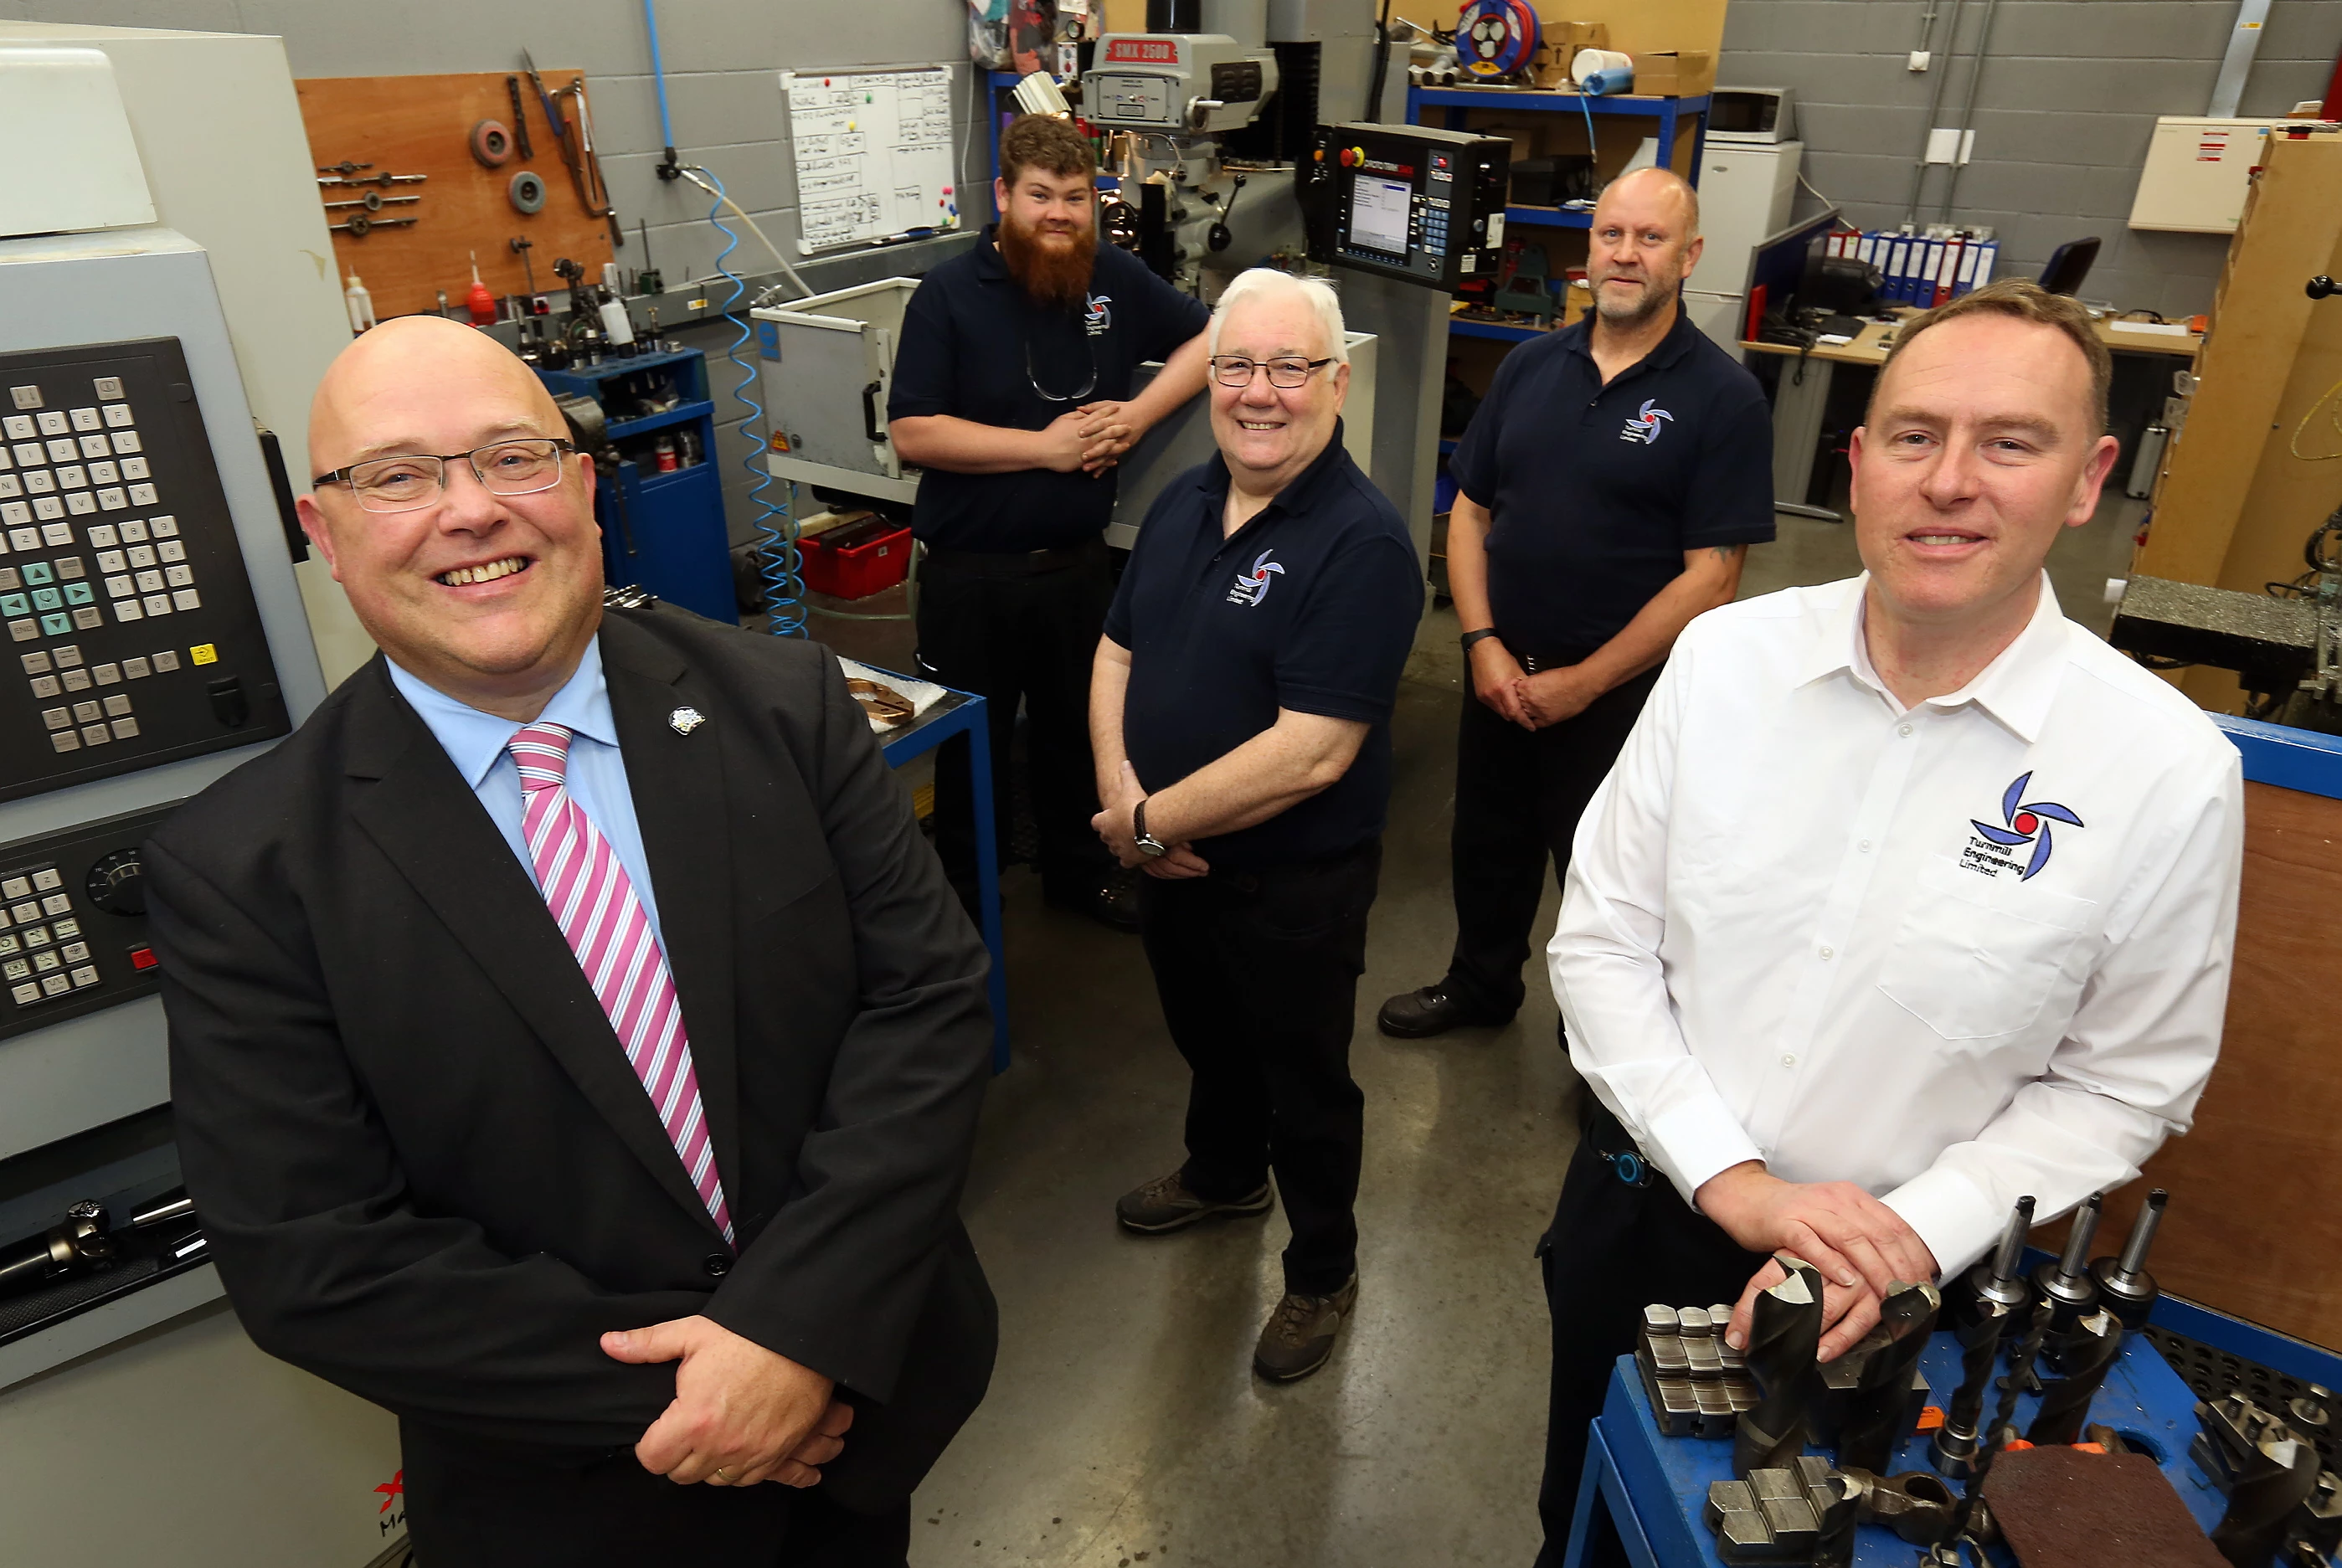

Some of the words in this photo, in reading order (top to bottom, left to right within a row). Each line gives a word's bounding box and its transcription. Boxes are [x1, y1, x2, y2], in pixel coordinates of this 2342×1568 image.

[1115, 44, 1139, 58] SMX
[1142, 44, 1169, 59] 2500
[14, 625, 33, 635] END
[99, 670, 114, 678] ALT
[127, 665, 145, 673] DEL
[65, 676, 88, 685] CTRL
[1969, 836, 2012, 856] Turnmill
[1963, 847, 2025, 875] Engineering
[1959, 859, 1998, 877] Limited
